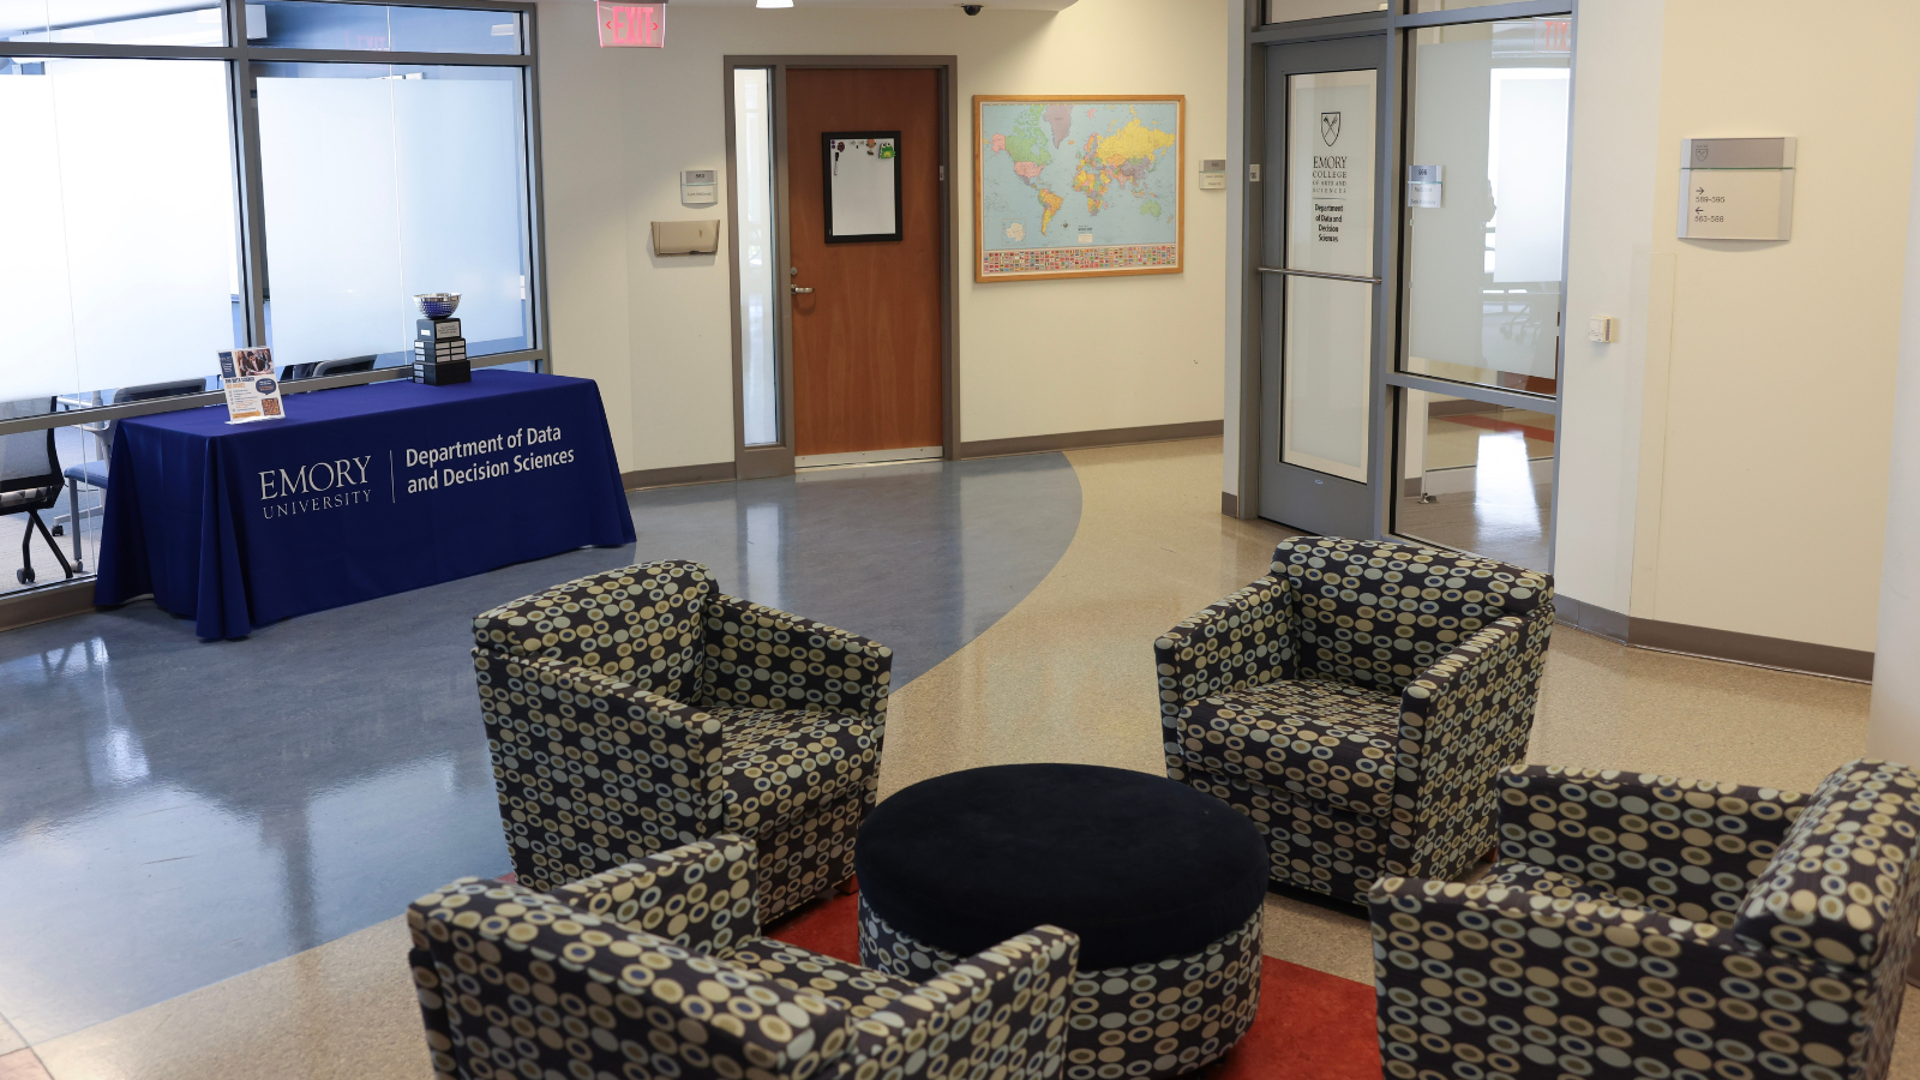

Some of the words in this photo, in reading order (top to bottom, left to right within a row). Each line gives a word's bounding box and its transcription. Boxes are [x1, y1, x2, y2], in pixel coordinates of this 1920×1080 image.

[612, 6, 654, 44] EXIT
[1313, 156, 1347, 169] EMORY
[1312, 170, 1347, 178] COLLEGE
[1315, 203, 1343, 213] Department
[1321, 214, 1332, 222] Data
[1333, 215, 1342, 223] and
[1318, 224, 1338, 232] Decision
[1318, 233, 1338, 242] Sciences
[406, 434, 503, 468] Department
[507, 428, 523, 449] of
[527, 426, 561, 445] Data
[258, 455, 371, 500] EMORY
[407, 470, 438, 493] and
[443, 461, 509, 486] Decision
[514, 449, 575, 473] Sciences
[263, 489, 371, 519] UNIVERSITY
